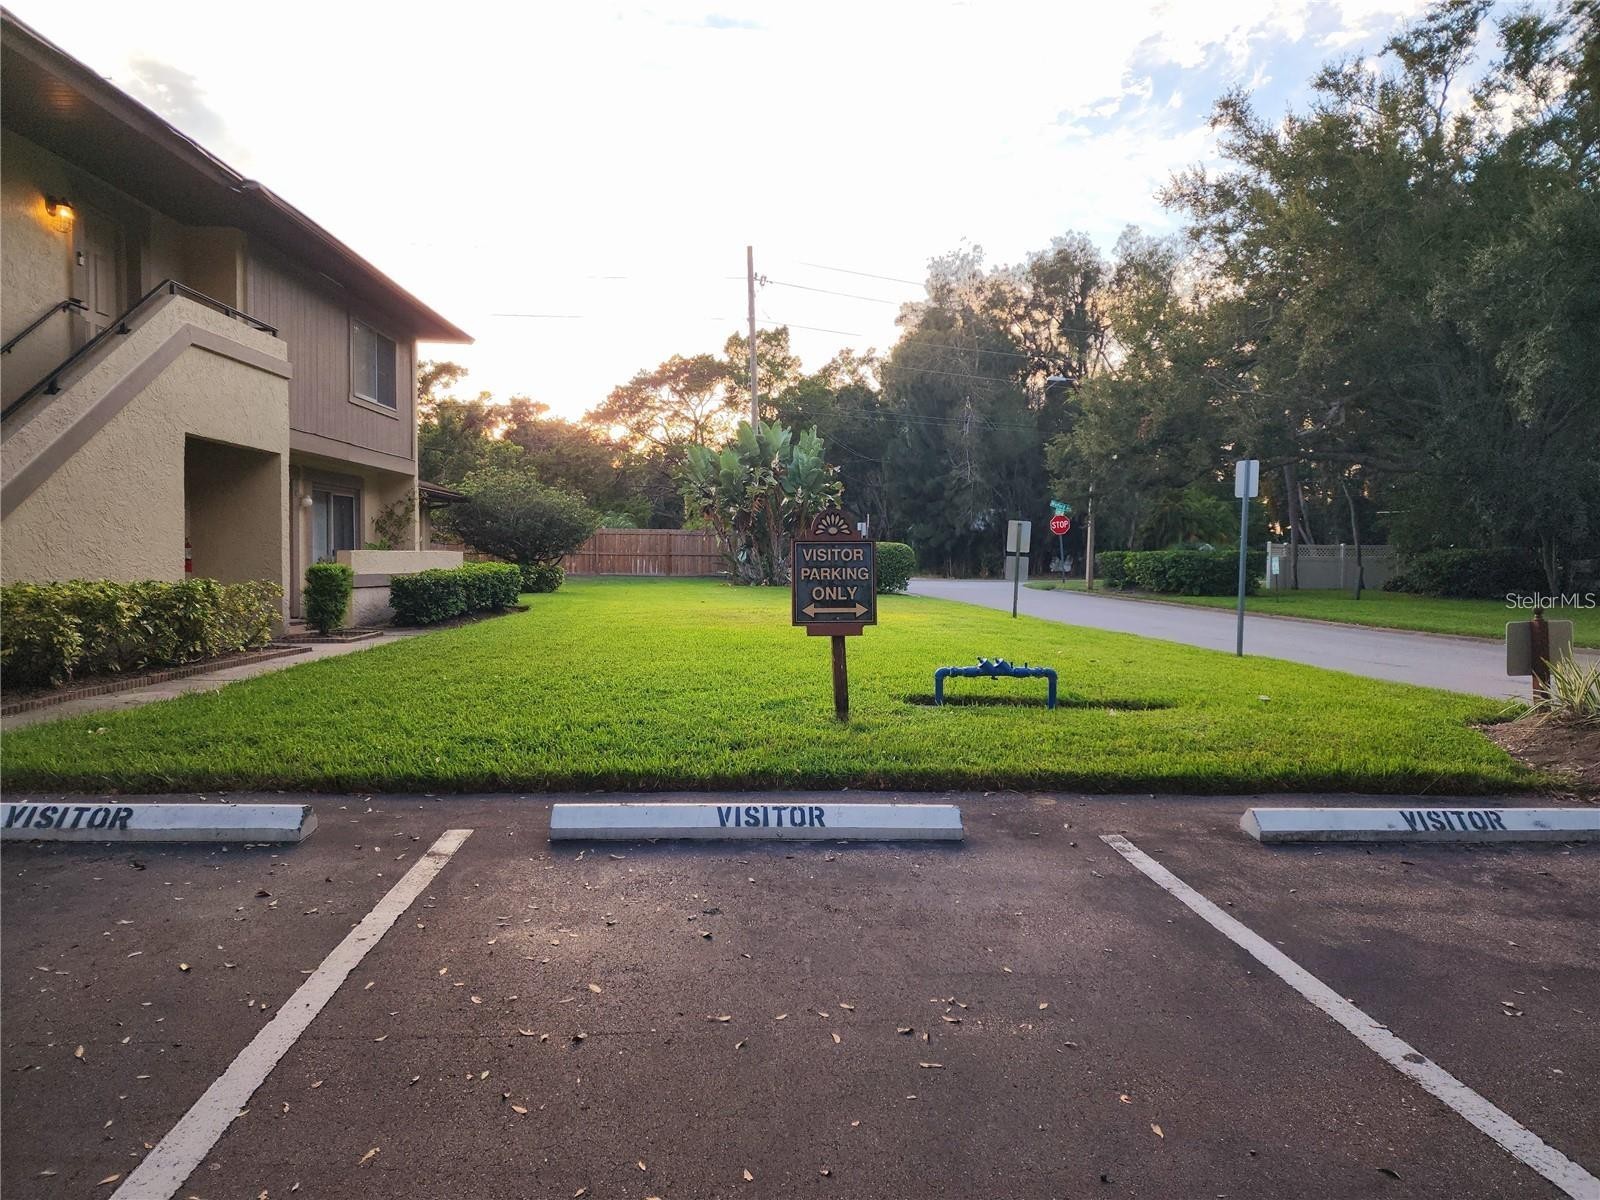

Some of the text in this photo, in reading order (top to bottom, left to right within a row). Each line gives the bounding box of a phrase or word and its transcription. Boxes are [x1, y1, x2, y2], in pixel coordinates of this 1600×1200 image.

[1051, 520, 1069, 529] STOP
[803, 548, 864, 561] VISITOR
[801, 567, 869, 580] PARKING
[812, 586, 858, 601] ONLY
[5, 805, 134, 830] VISITOR
[716, 805, 826, 827] VISITOR
[1399, 810, 1507, 832] VISITOR
